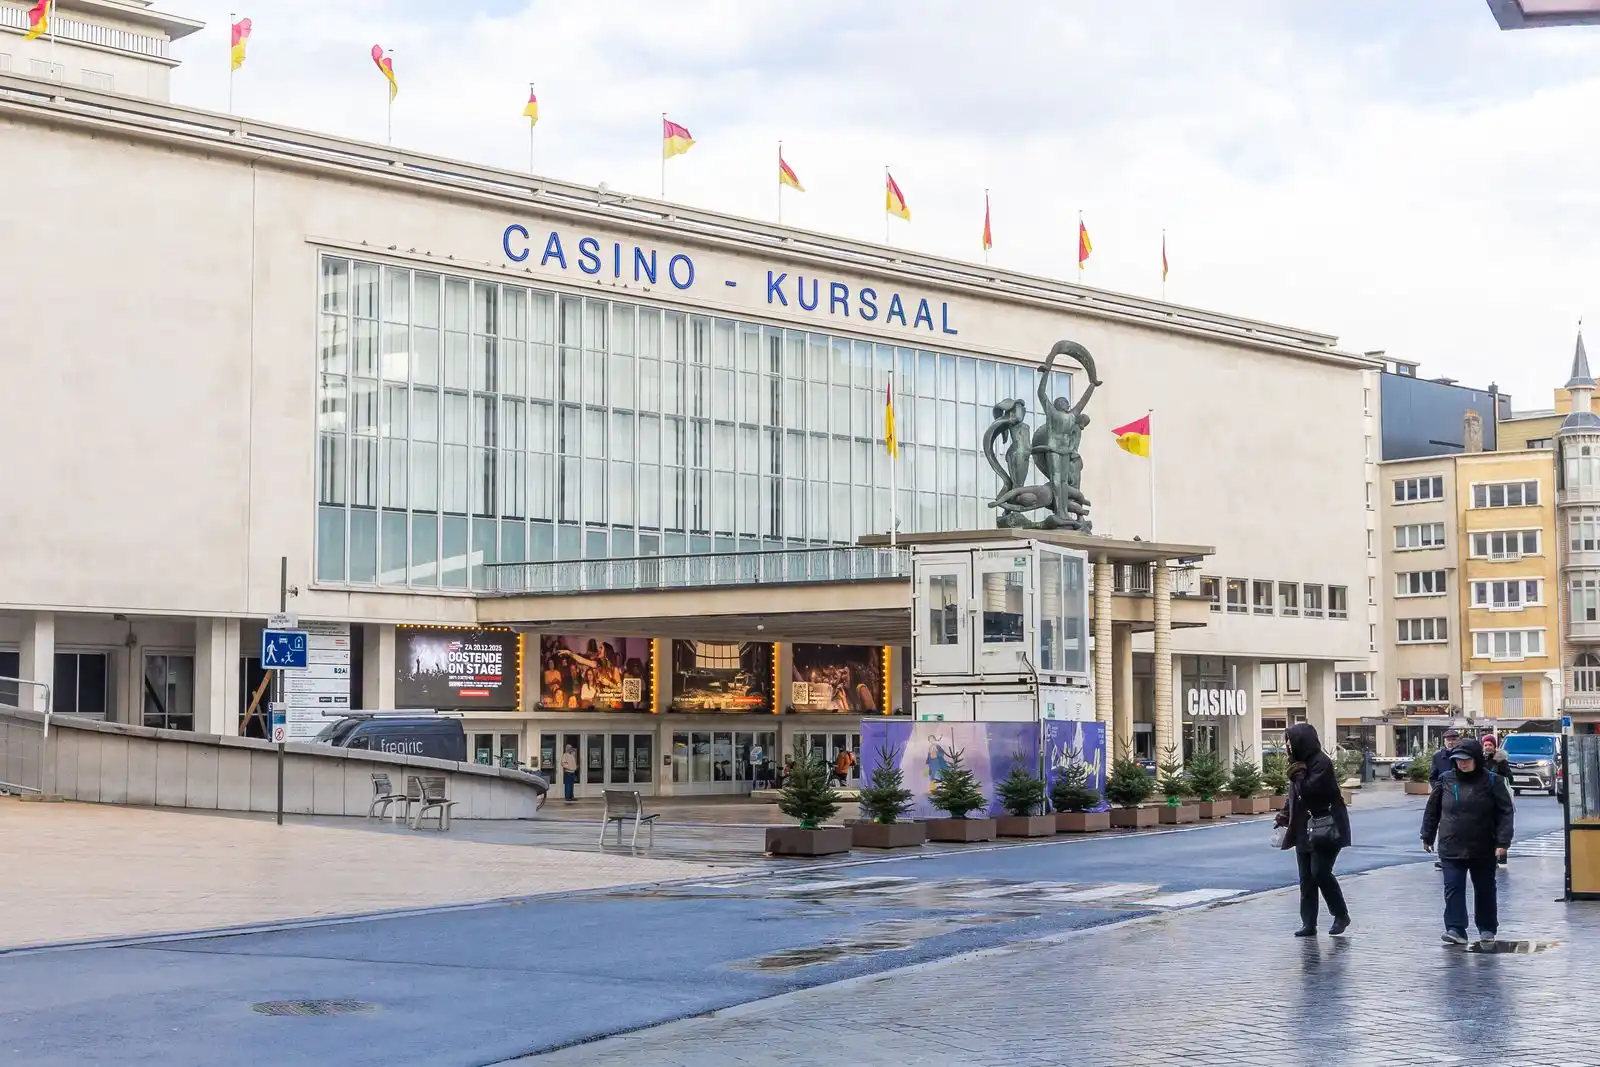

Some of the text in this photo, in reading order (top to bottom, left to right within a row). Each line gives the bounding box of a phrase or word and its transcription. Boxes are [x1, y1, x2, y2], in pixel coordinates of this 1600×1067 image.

[503, 223, 695, 289] CASINO
[767, 271, 958, 335] KURSAAL
[464, 643, 473, 651] ZA
[473, 644, 503, 652] 20.12.2025
[448, 651, 503, 664] OOSTENDE
[448, 663, 503, 676] ON STAGE
[1187, 688, 1247, 716] CASINO
